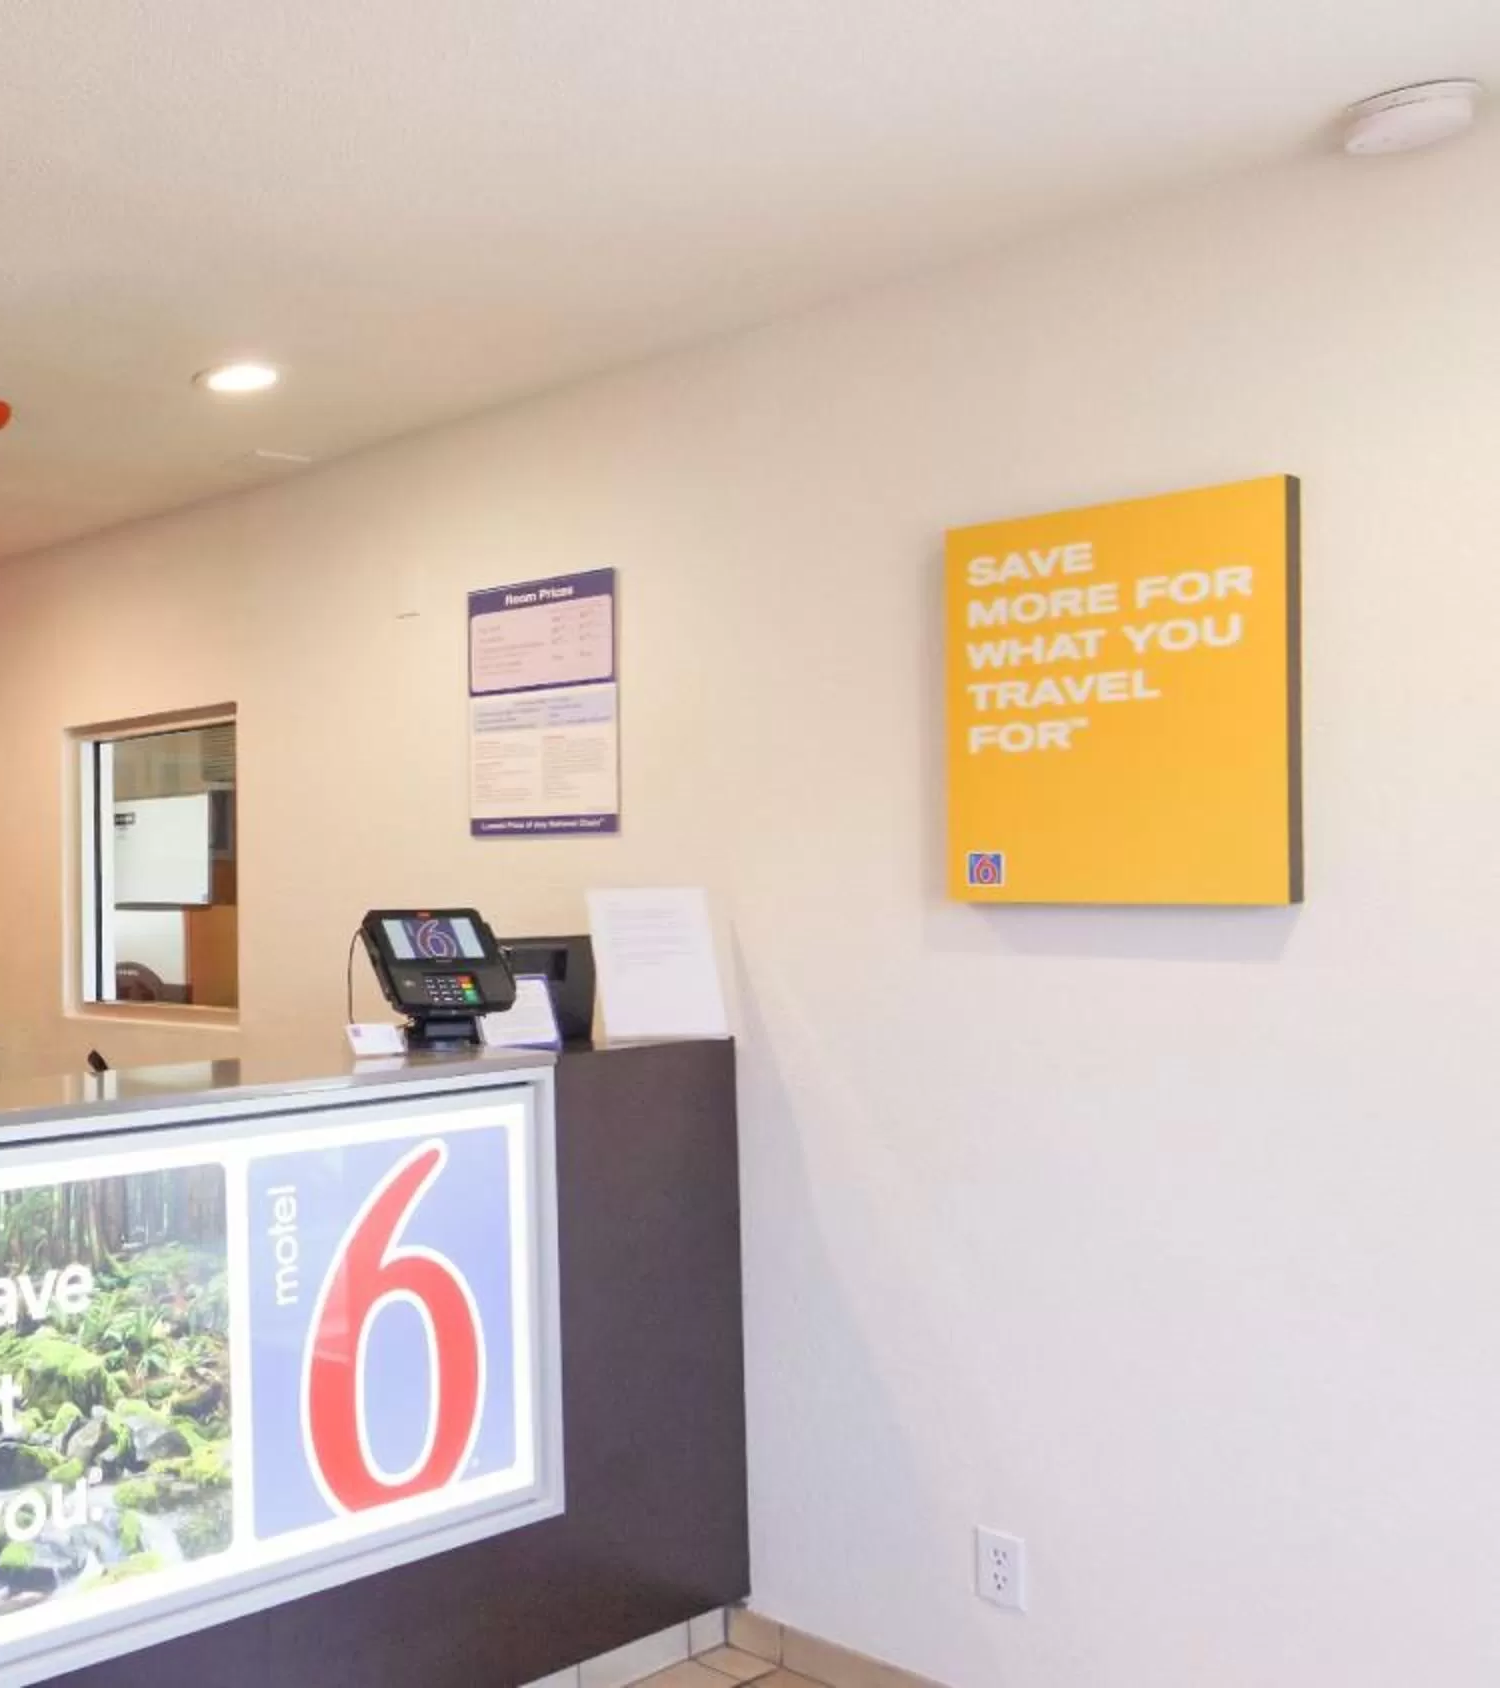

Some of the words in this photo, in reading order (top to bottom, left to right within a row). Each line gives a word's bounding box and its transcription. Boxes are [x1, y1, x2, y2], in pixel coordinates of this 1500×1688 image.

[966, 541, 1093, 587] SAVE
[968, 582, 1119, 629] MORE
[1135, 565, 1253, 609] FOR
[966, 628, 1106, 670] WHAT
[1122, 612, 1242, 655] YOU
[967, 669, 1162, 711] TRAVEL
[267, 1184, 299, 1306] motel
[300, 1137, 487, 1516] 6
